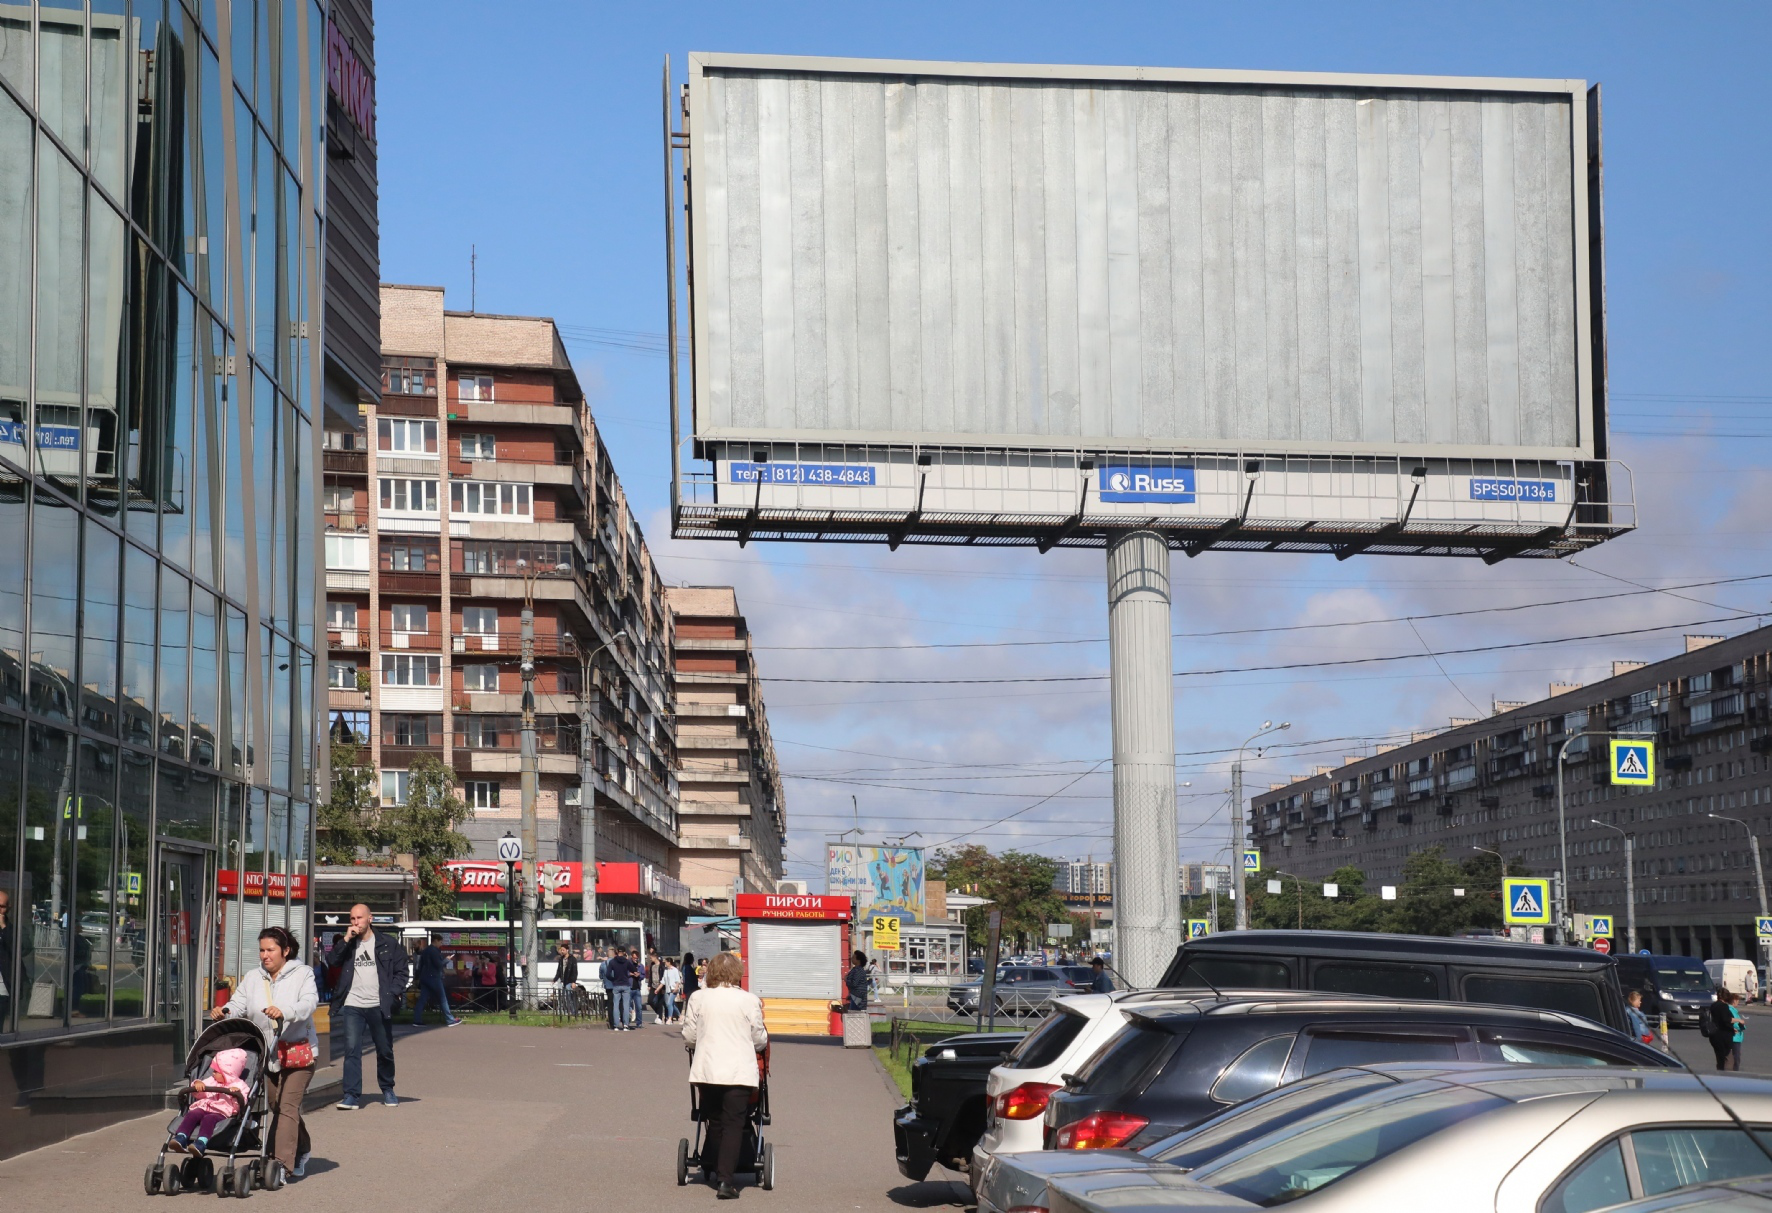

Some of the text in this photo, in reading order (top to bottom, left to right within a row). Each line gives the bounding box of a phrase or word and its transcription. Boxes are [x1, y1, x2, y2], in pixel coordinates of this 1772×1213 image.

[736, 467, 871, 483] тел.: (812) 438-4848
[1135, 474, 1185, 492] Russ
[829, 850, 853, 863] РИО
[766, 896, 822, 908] ПИРОГИ
[762, 909, 794, 917] РУЧНОЙ
